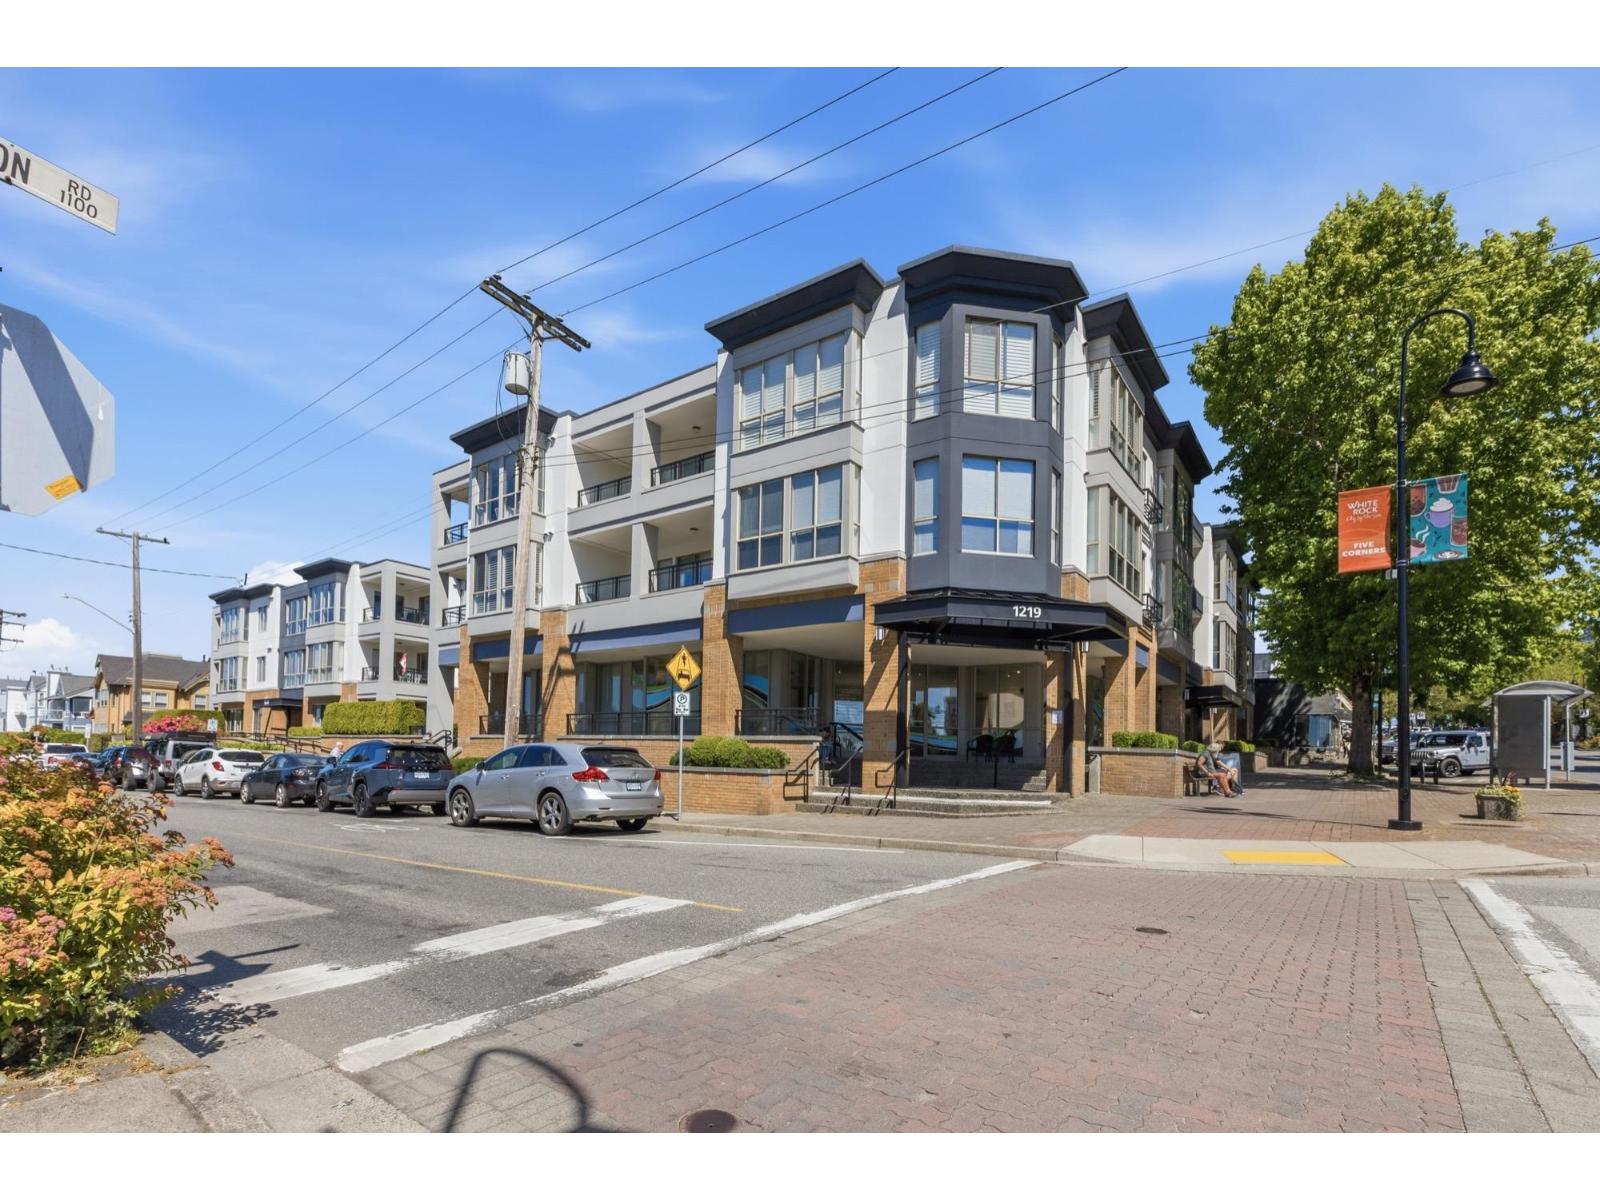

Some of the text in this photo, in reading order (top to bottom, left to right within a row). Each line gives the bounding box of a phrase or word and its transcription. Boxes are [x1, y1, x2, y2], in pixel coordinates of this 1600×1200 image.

[67, 179, 92, 202] RD
[60, 190, 98, 219] 1100
[1347, 500, 1378, 509] WHITE
[1342, 547, 1386, 556] CORNERS
[1012, 605, 1042, 618] 1219
